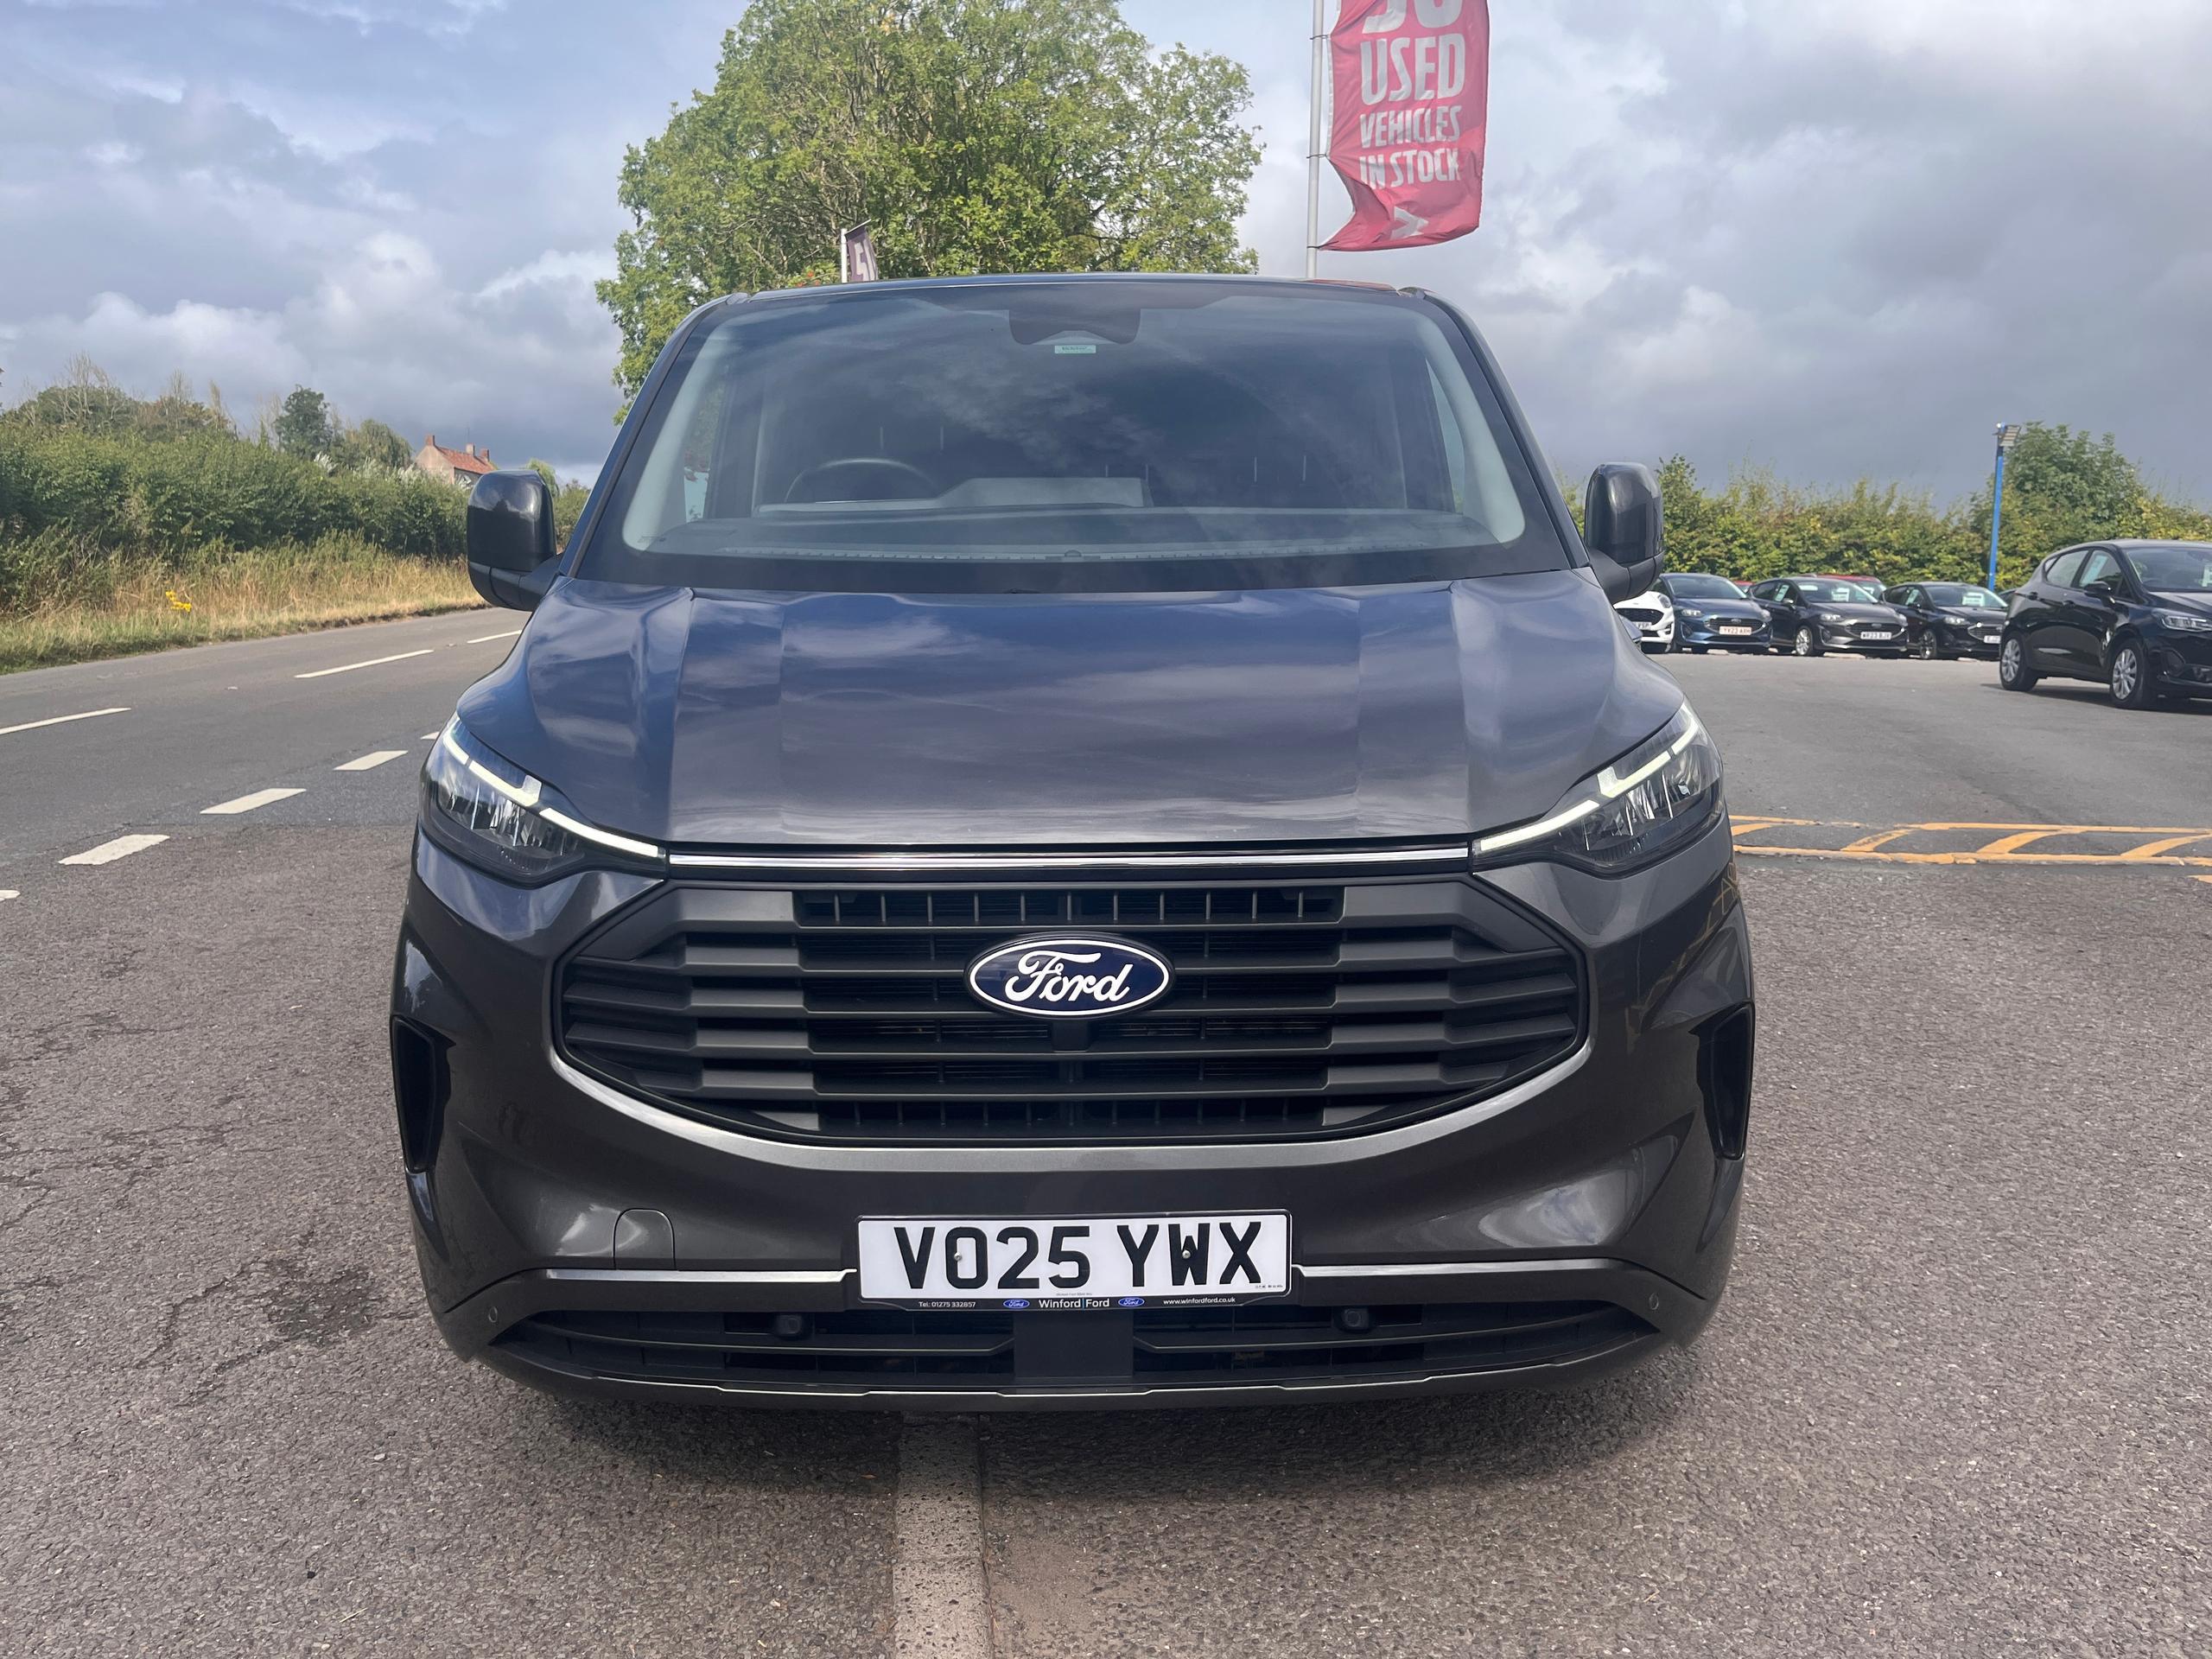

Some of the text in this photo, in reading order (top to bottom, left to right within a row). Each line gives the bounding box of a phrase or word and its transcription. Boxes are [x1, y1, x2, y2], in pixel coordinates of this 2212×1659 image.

[1360, 33, 1465, 105] USED
[1359, 105, 1462, 149] VEHICLES
[1359, 148, 1461, 189] IN STOCK
[1004, 950, 1134, 1002] Ford
[893, 1221, 1262, 1289] VO25 YWX
[1039, 1298, 1110, 1308] Winford Ford
[1163, 1296, 1236, 1305] www.winfordford.co.uk
